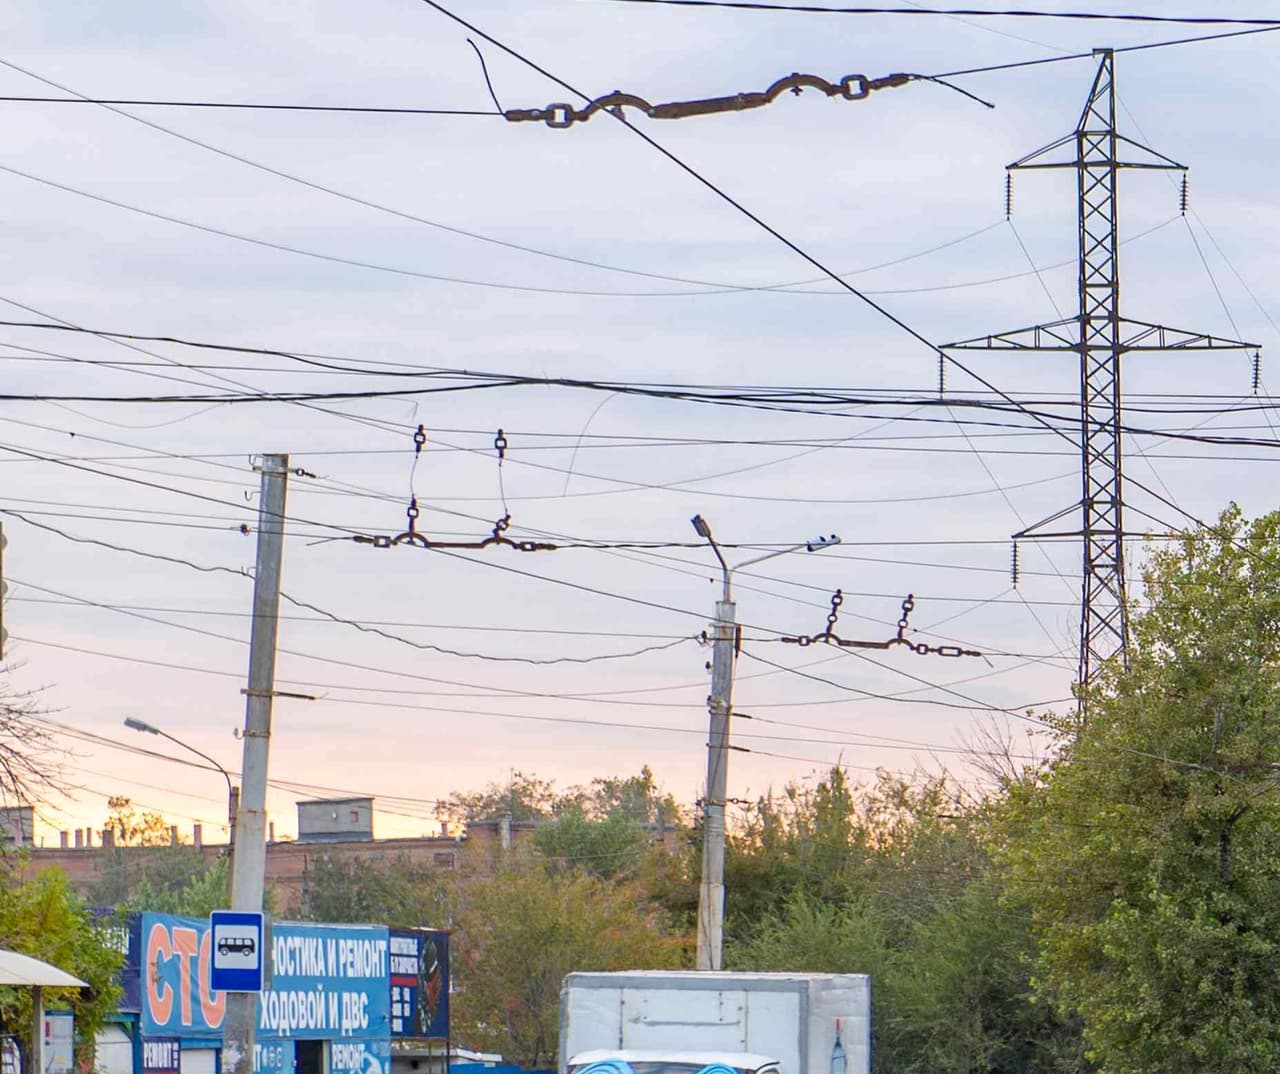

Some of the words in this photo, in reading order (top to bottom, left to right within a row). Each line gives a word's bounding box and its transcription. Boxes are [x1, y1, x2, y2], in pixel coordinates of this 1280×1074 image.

[271, 935, 326, 977] НОСТИКА
[327, 938, 337, 977] И
[339, 937, 388, 978] РЕМОНТ
[260, 983, 326, 1037] ХОДОВОЙ
[328, 991, 339, 1029] И
[341, 991, 369, 1037] ДВС
